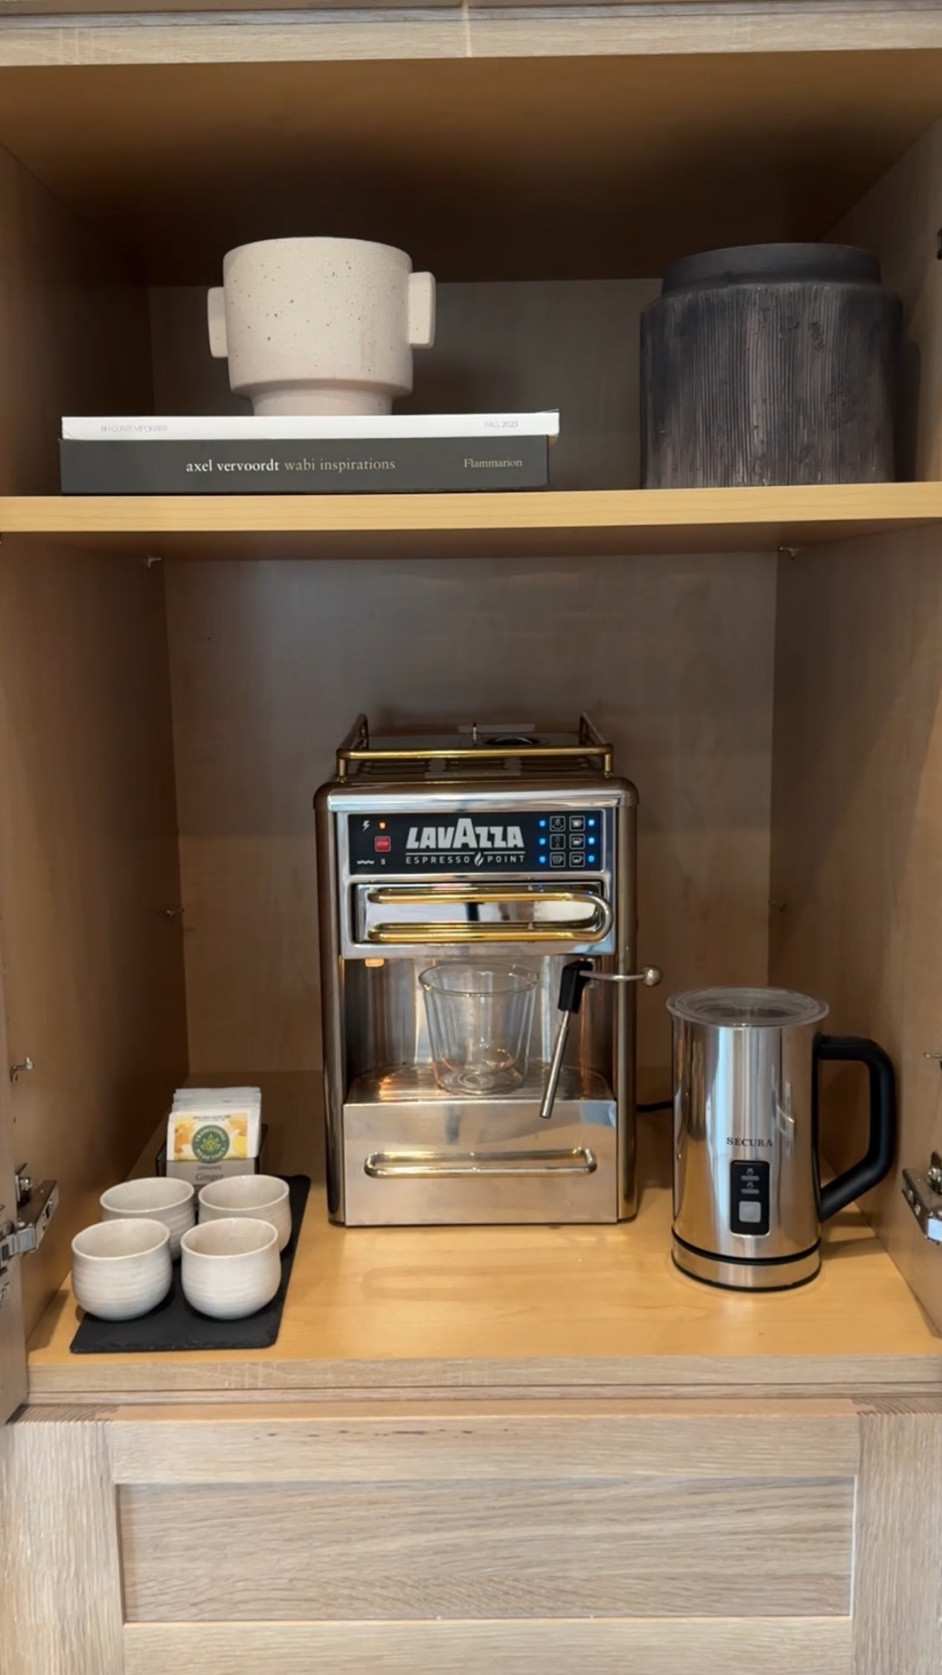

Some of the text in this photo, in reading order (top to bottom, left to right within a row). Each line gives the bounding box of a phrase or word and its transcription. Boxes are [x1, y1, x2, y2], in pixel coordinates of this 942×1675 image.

[484, 420, 500, 428] FALL
[186, 457, 396, 473] axel vervoordt wabi inspirations
[463, 458, 523, 468] Flammarion
[406, 818, 525, 849] LAVAZZA
[405, 855, 526, 865] ESPRESSO POINT
[726, 1136, 773, 1147] SECURA
